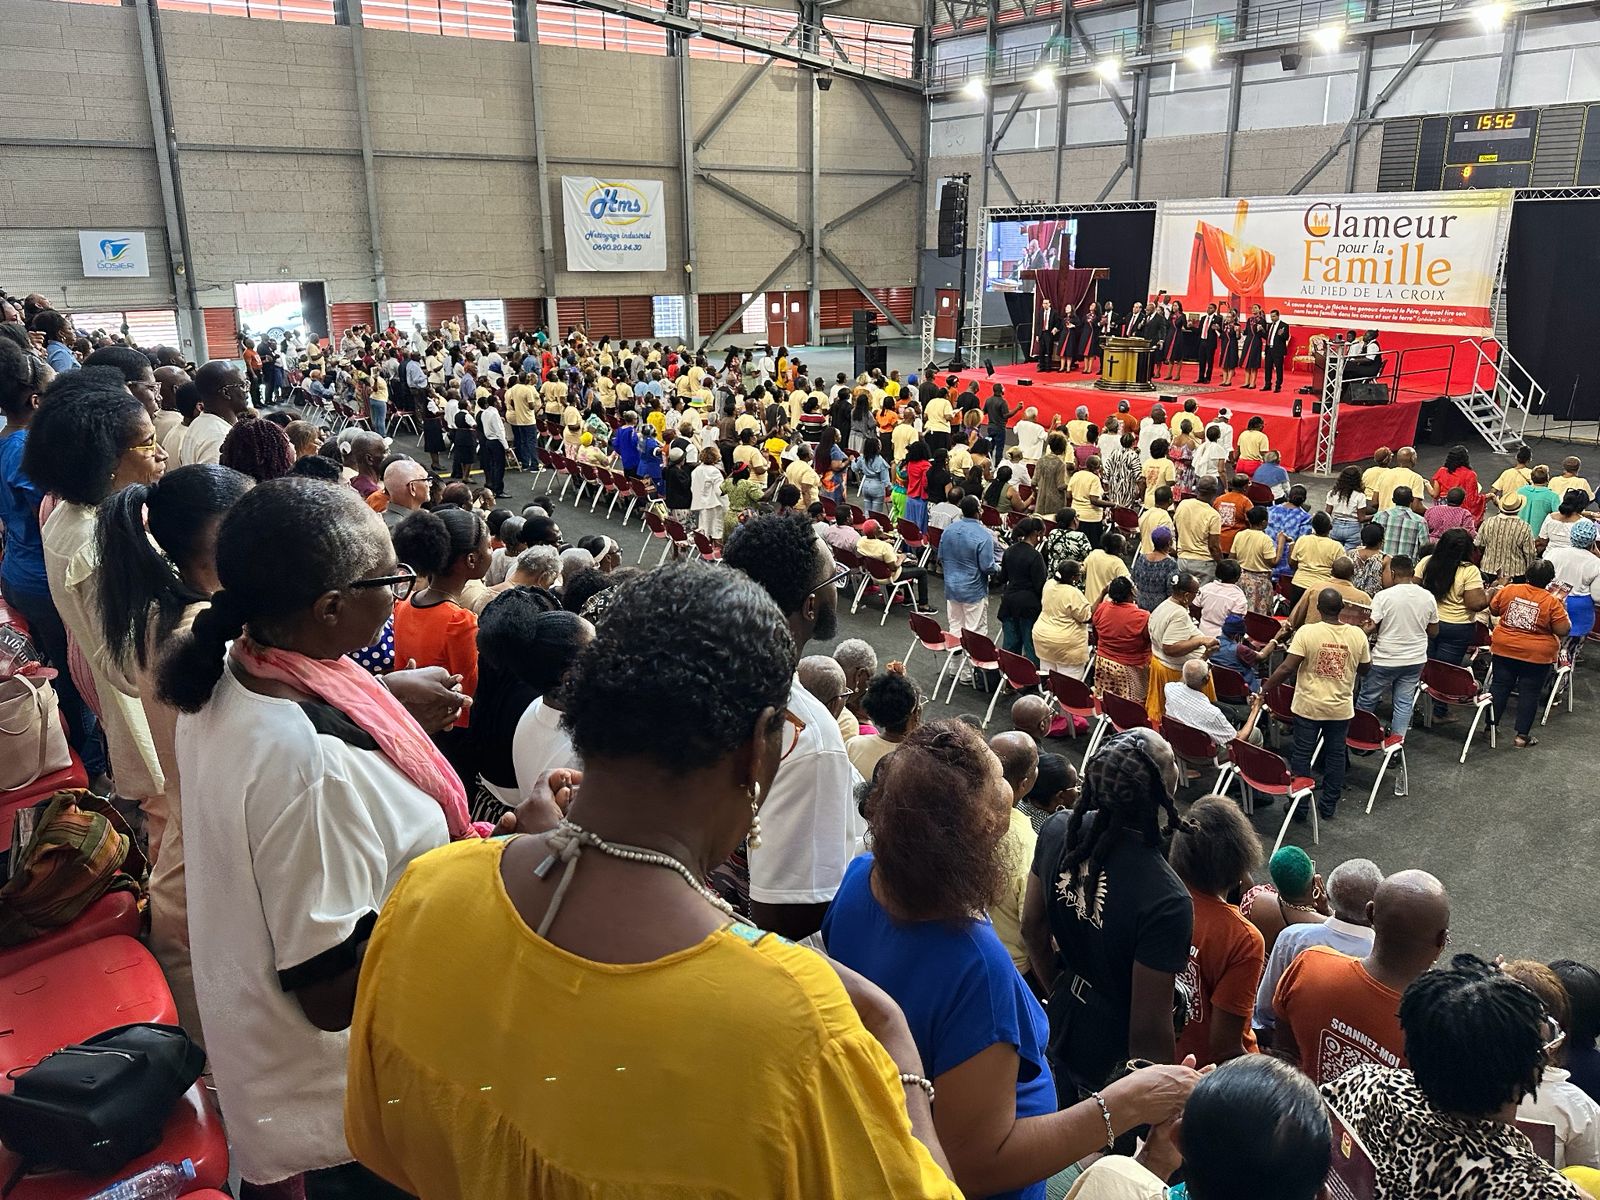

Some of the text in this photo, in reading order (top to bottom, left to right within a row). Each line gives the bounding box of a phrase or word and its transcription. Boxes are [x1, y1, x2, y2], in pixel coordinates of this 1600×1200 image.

[1477, 113, 1516, 130] 15:52
[590, 188, 641, 220] Hms
[1304, 202, 1458, 238] Clameur
[584, 230, 652, 243] Nettoyage industriel
[1336, 240, 1385, 257] pour la
[1302, 239, 1452, 287] Famille
[1300, 285, 1446, 301] AU PIED DE LA CROIX
[1319, 309, 1337, 317] famille
[1421, 308, 1444, 316] duquel
[1330, 1017, 1401, 1068] SCANNEZ-MOI
